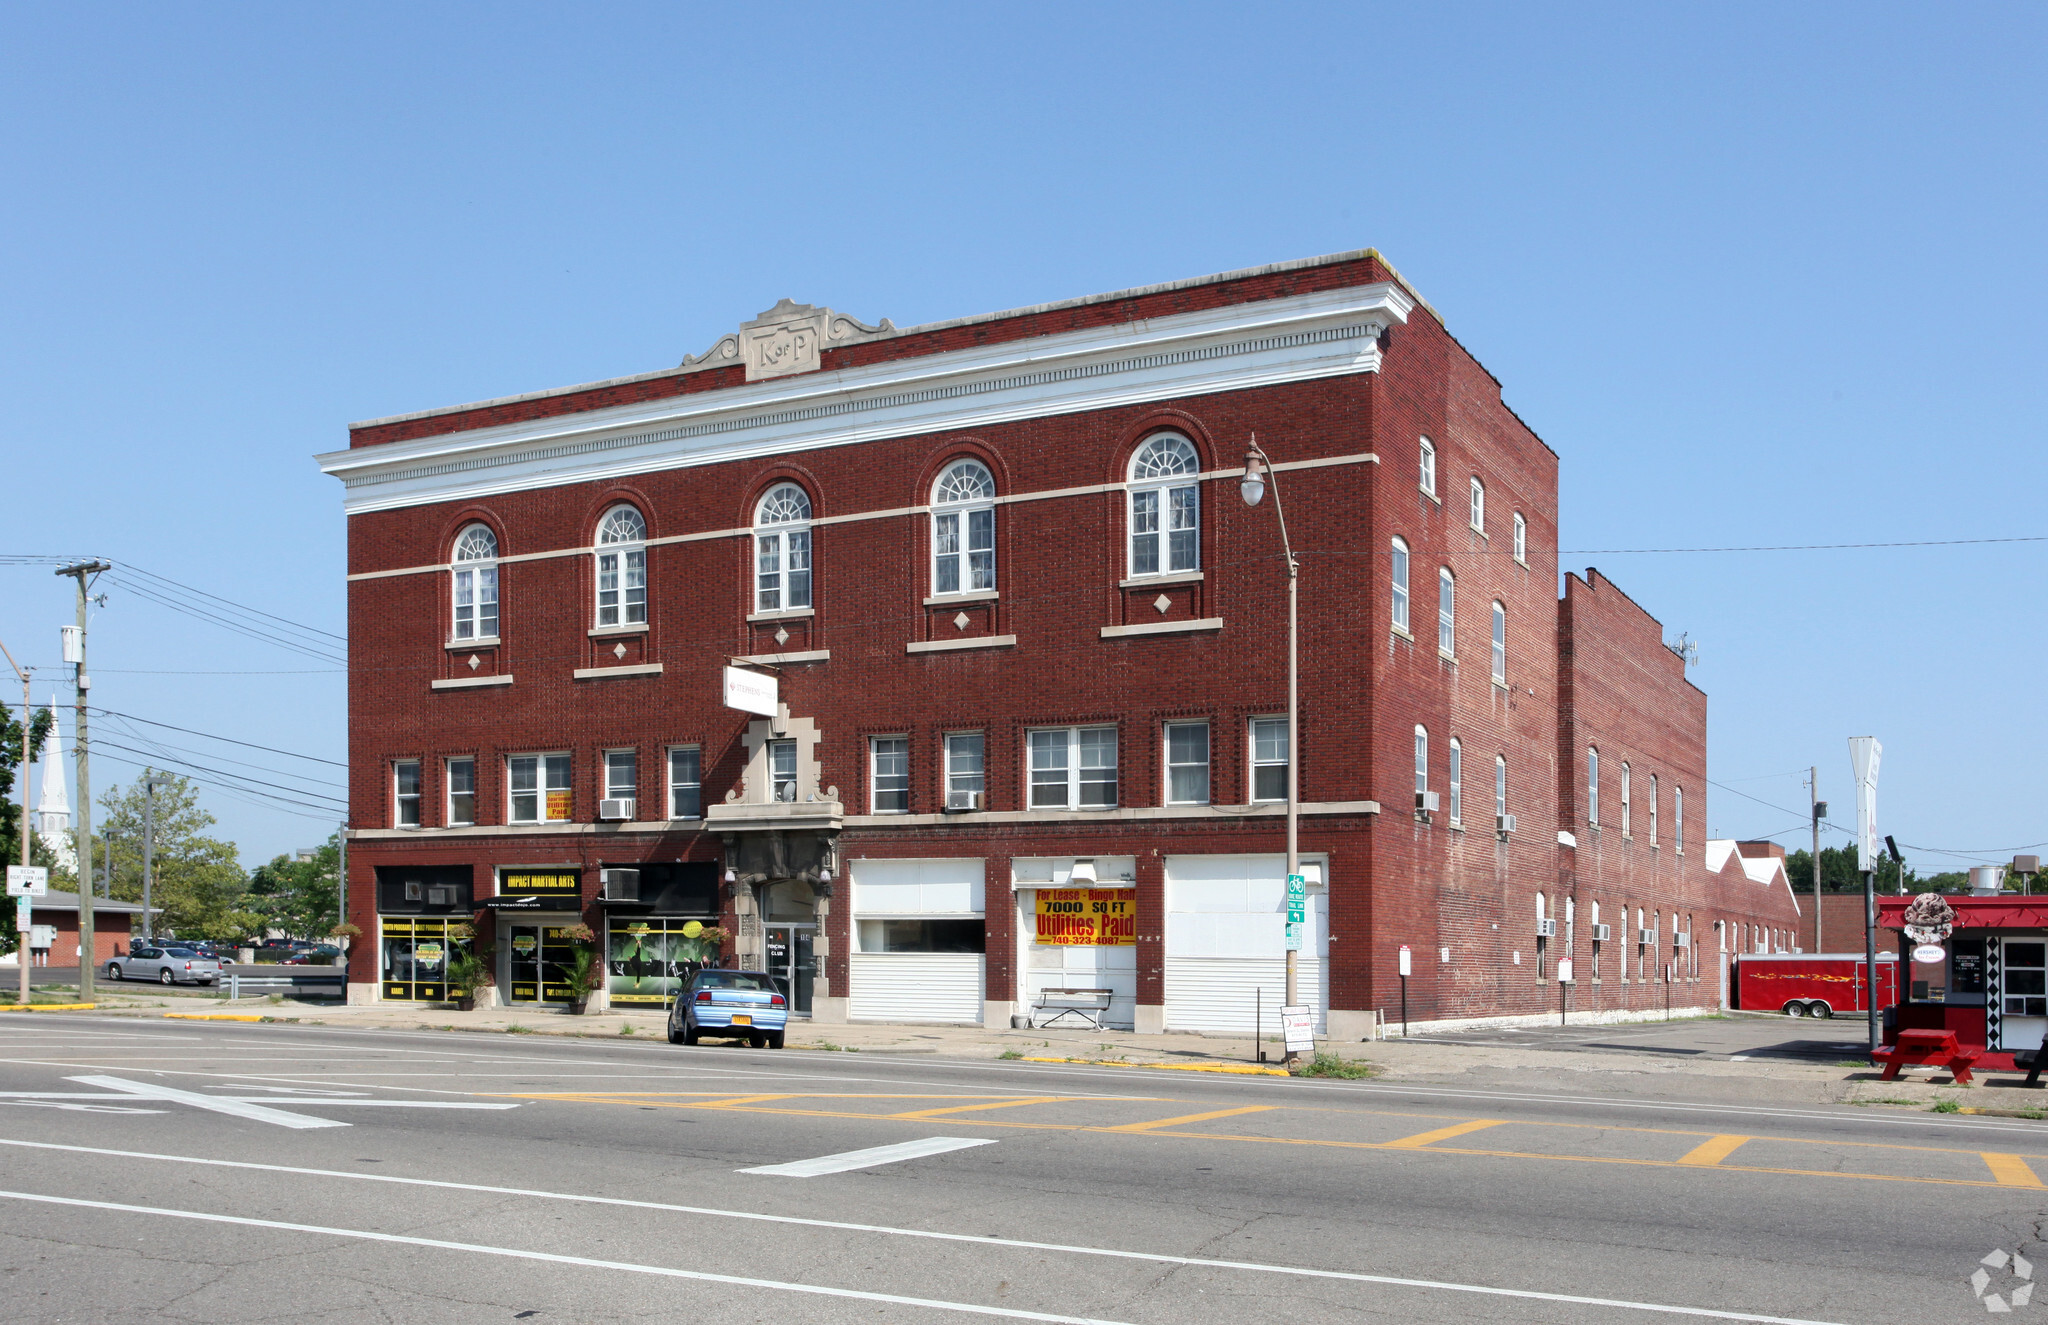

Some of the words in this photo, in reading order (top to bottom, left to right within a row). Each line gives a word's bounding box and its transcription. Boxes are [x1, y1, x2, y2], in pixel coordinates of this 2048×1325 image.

[761, 341, 778, 367] K
[793, 336, 807, 361] P
[507, 875, 531, 888] IMPACT
[531, 875, 558, 888] MARTIAL
[558, 875, 575, 888] ARTS
[1036, 889, 1051, 901] For
[1053, 889, 1080, 901] Lease
[1088, 889, 1115, 902] Bingo
[1117, 889, 1136, 901] Hall
[1044, 901, 1084, 913] 7000
[1092, 901, 1108, 914] SQ
[1111, 901, 1126, 913] FT
[1036, 913, 1095, 936] Utilities
[1101, 913, 1135, 937] Paid
[1051, 936, 1120, 945] 740-323-4087
